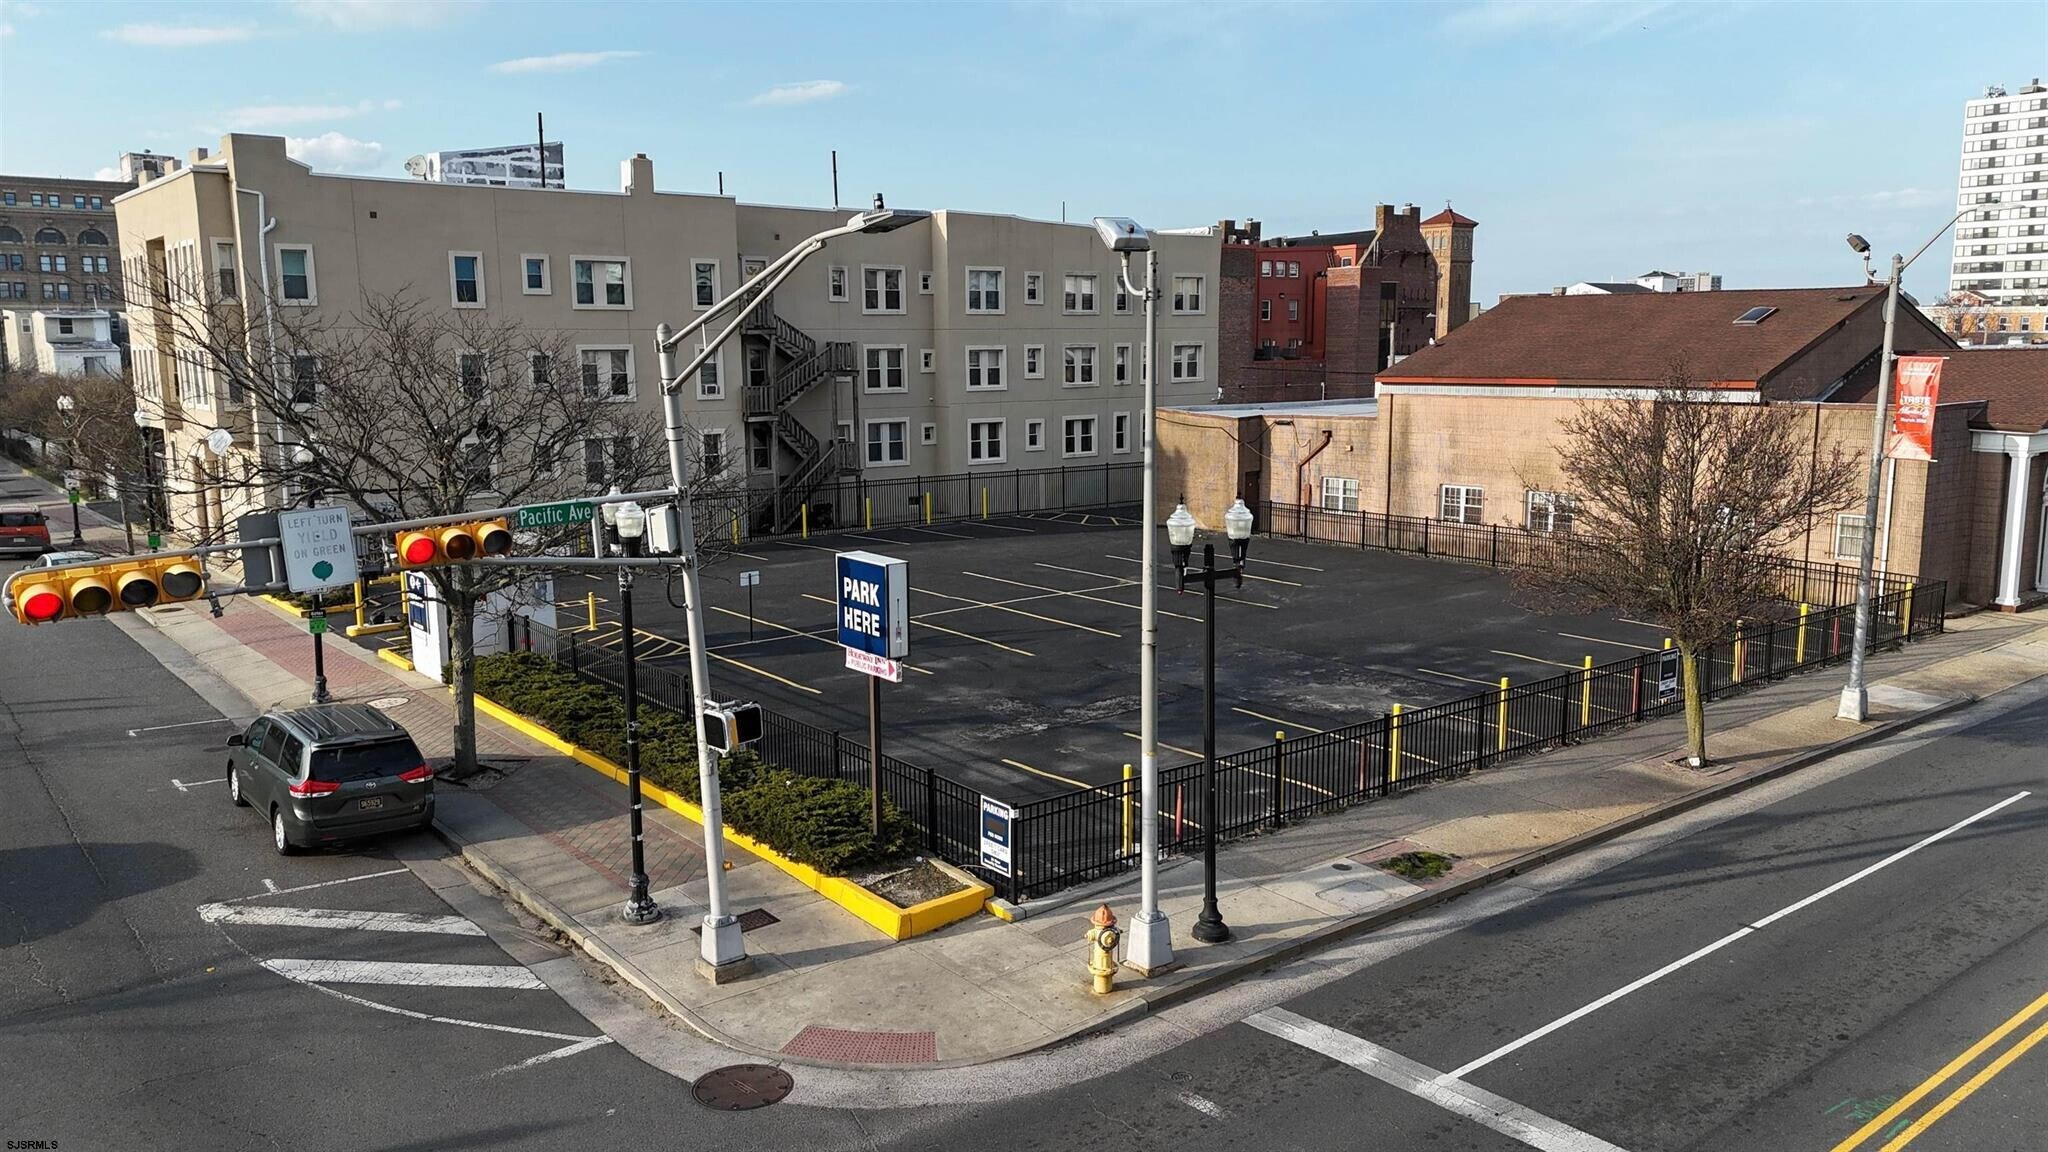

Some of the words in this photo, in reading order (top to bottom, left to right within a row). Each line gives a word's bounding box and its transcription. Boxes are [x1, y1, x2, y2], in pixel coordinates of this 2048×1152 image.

[287, 517, 312, 529] LEFT
[316, 512, 343, 526] TURN
[520, 507, 563, 527] Pacific
[569, 504, 592, 521] Ave
[298, 528, 338, 544] YIELD
[294, 548, 308, 560] ON
[313, 543, 346, 557] GREEN
[843, 576, 880, 608] PARK
[844, 605, 880, 638] HERE
[983, 801, 1009, 820] PARKING
